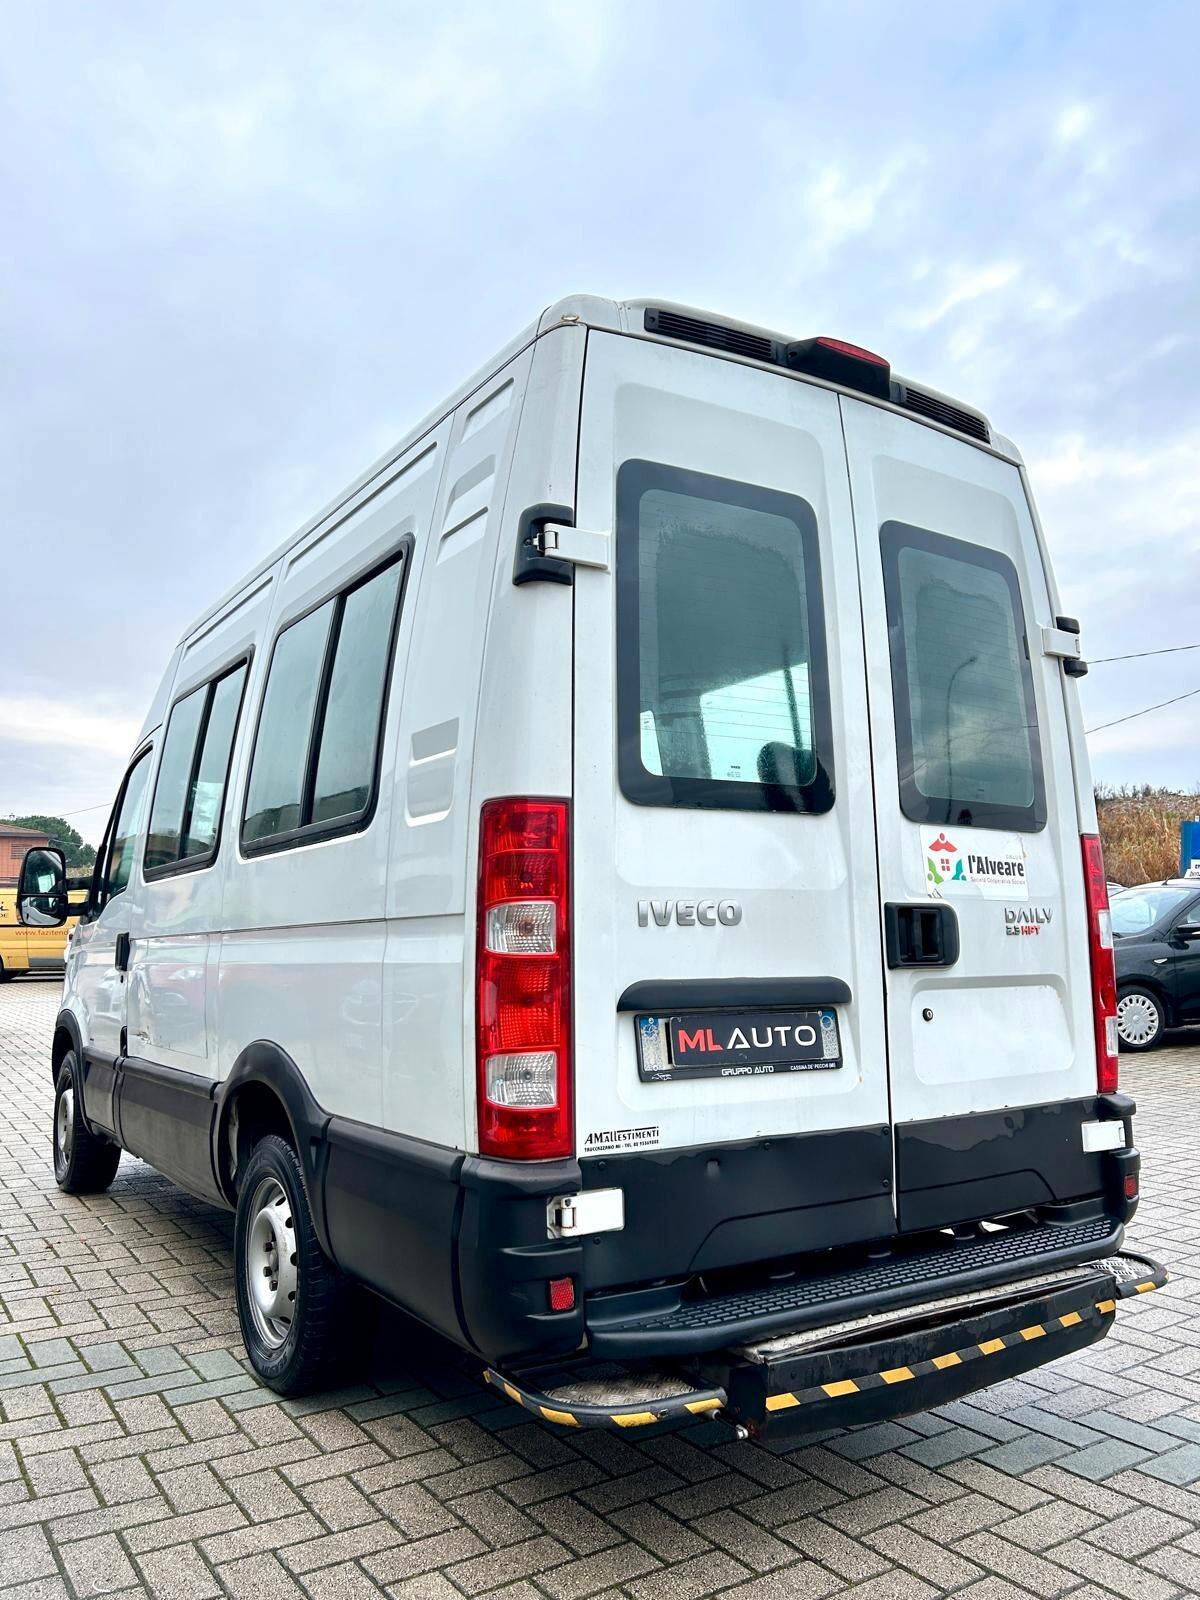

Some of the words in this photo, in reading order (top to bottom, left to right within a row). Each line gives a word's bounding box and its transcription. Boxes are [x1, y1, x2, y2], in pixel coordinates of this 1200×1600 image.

[968, 855, 1025, 876] l'Alveare
[638, 899, 742, 928] IVECO
[1005, 907, 1053, 923] DAILY
[678, 1028, 723, 1053] ML
[727, 1025, 817, 1050] AUTO
[722, 1066, 752, 1077] GRUPPO
[754, 1065, 775, 1074] AUTO
